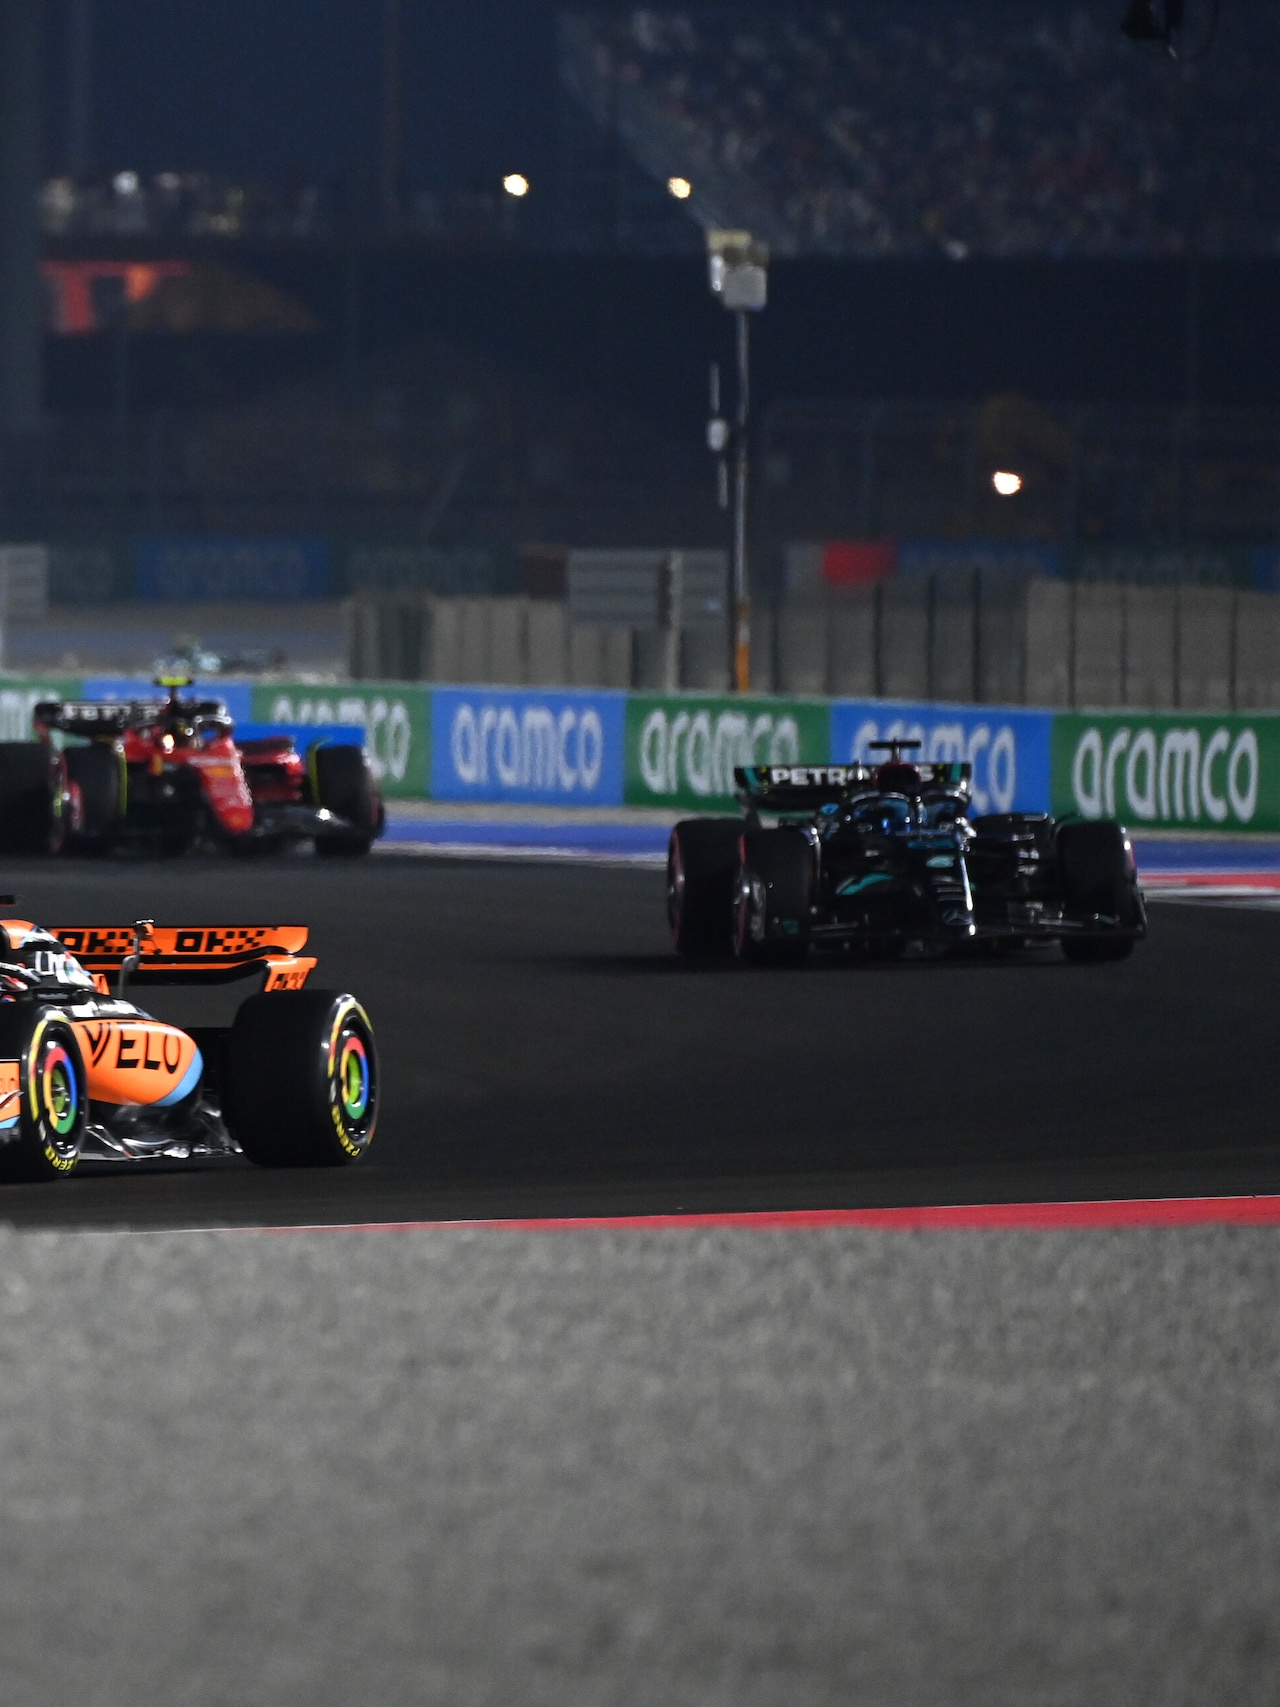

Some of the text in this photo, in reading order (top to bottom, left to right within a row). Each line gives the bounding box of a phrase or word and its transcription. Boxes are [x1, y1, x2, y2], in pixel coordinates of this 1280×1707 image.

[451, 703, 604, 773] aramco
[771, 766, 935, 786] PETRS
[1073, 727, 1259, 823] aramco
[81, 1021, 182, 1075] VELO
